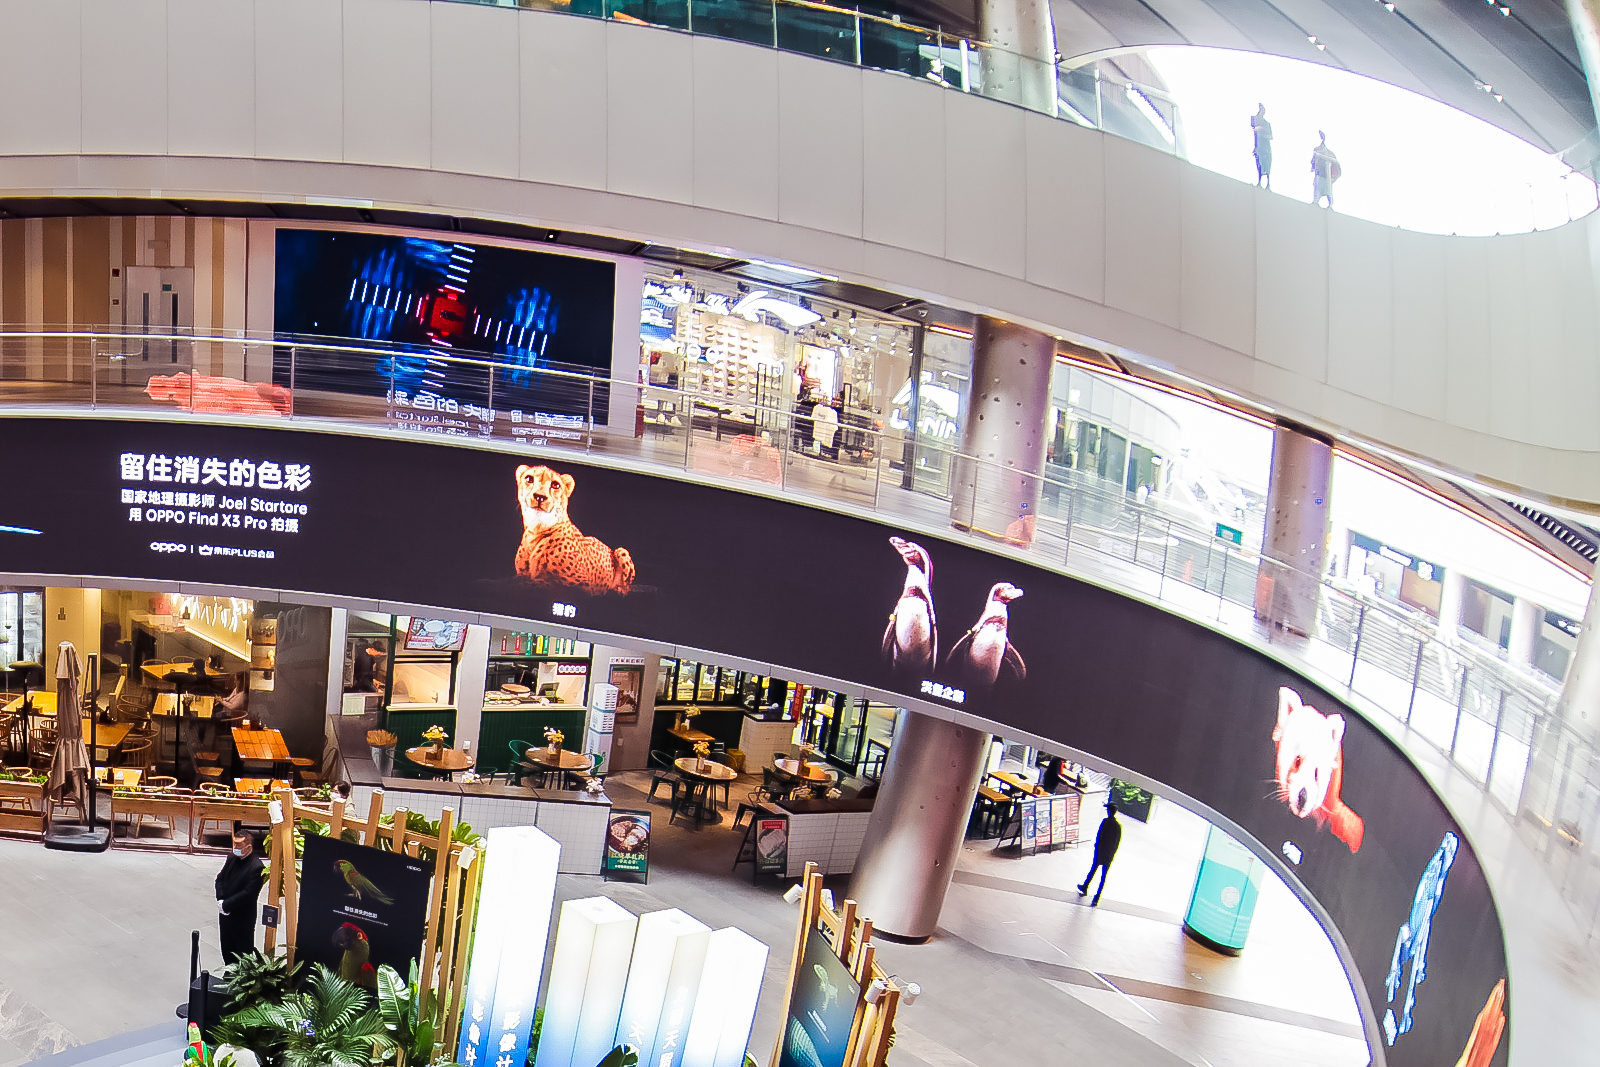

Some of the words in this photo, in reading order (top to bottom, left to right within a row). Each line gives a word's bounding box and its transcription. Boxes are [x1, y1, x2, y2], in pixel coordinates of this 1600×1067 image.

[120, 453, 311, 492] 留住消失的色彩
[121, 488, 215, 508] 国家地理摄影师
[218, 495, 247, 511] Joel
[250, 498, 308, 515] Startore
[129, 507, 142, 521] 用
[146, 509, 185, 523] OPPO
[189, 511, 218, 526] Find
[221, 514, 241, 528] X3
[244, 516, 267, 530] Pro
[270, 517, 299, 533] 拍摄
